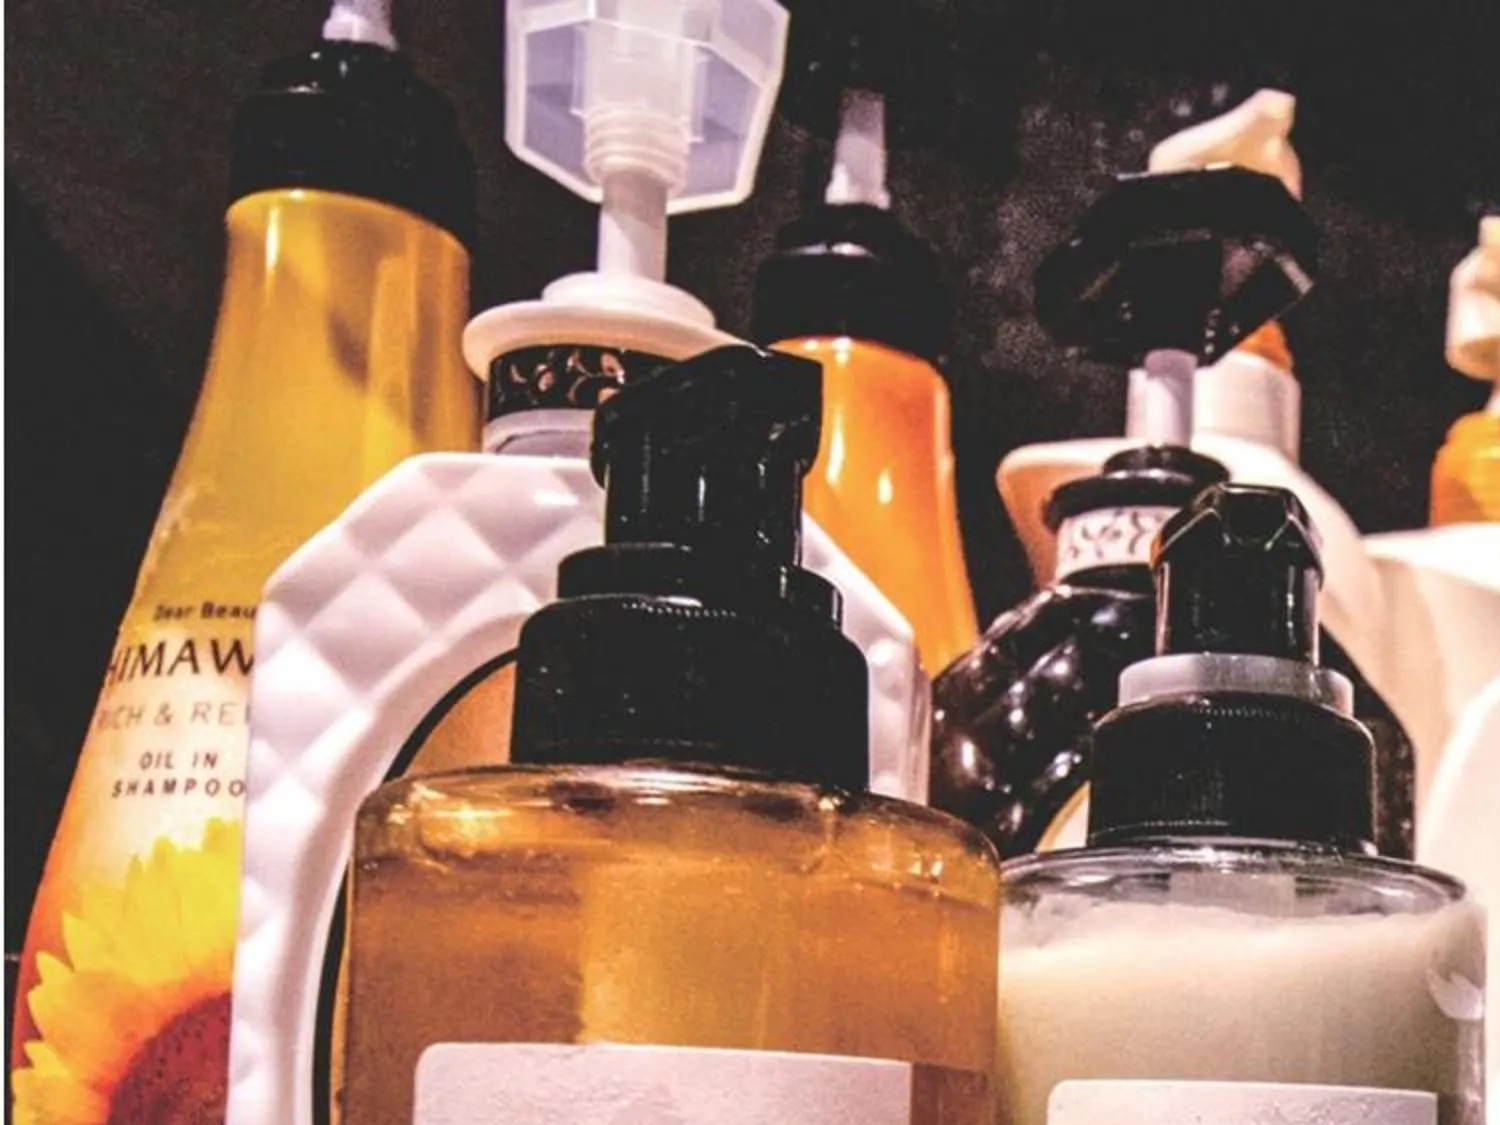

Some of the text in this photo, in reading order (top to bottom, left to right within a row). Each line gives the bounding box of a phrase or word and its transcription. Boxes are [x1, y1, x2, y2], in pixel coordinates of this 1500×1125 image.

[153, 603, 192, 621] Dear
[153, 702, 174, 725] &
[139, 751, 218, 769] OIL IN
[112, 779, 246, 799] SHAMPOO
